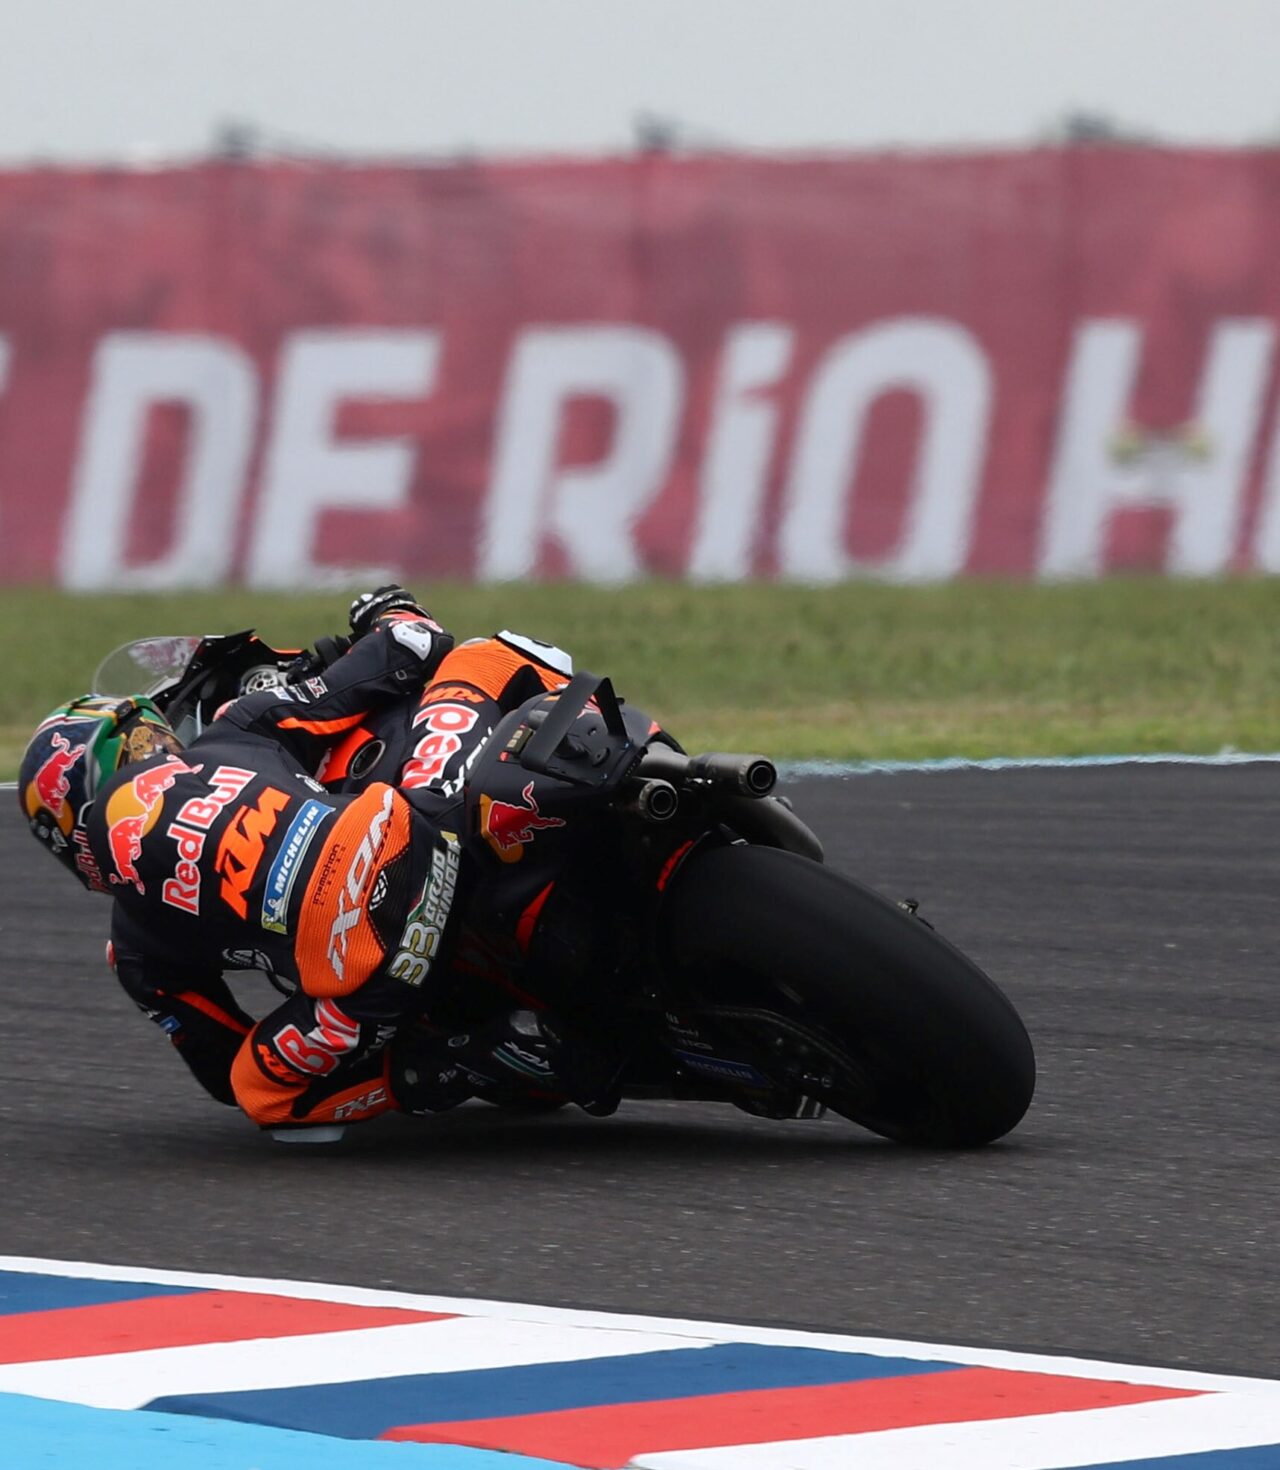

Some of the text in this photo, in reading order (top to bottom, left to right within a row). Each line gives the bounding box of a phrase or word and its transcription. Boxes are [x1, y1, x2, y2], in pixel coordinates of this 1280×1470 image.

[58, 329, 443, 592] DE
[1036, 318, 1280, 579] H
[162, 765, 258, 916] Red Bull
[214, 786, 292, 921] KTM
[274, 806, 320, 894] MICHELIN
[388, 846, 447, 987] 33 BRAD
